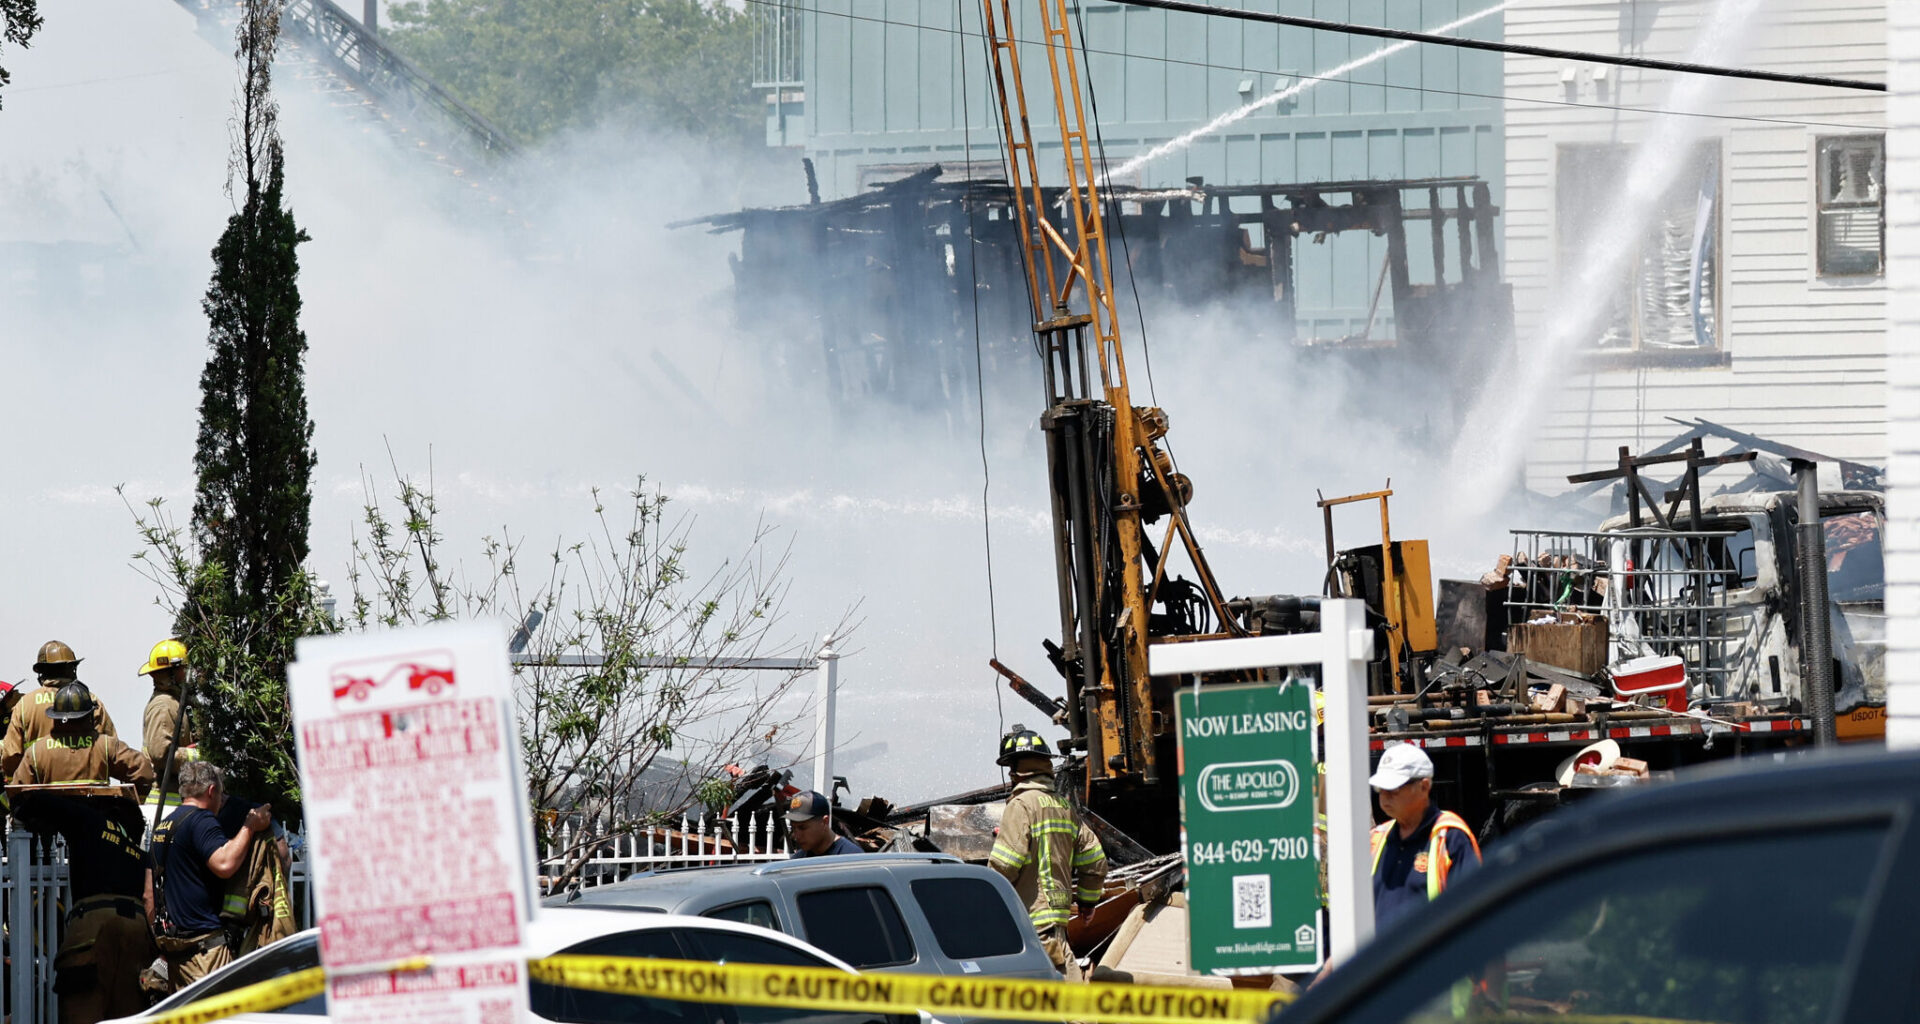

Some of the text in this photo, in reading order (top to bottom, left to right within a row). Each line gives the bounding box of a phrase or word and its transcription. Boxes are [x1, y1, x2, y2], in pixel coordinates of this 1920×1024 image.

[1185, 711, 1307, 738] NOW LEASING
[1851, 710, 1879, 721] USDOT
[46, 735, 93, 750] DALLAS
[1211, 770, 1286, 791] THE APOLLO
[1193, 836, 1308, 866] 844-629-7910
[600, 964, 728, 994] CAUTION
[764, 973, 893, 1003] CAUTION
[930, 982, 1058, 1012] CAUTION
[1097, 990, 1229, 1019] CAUTION
